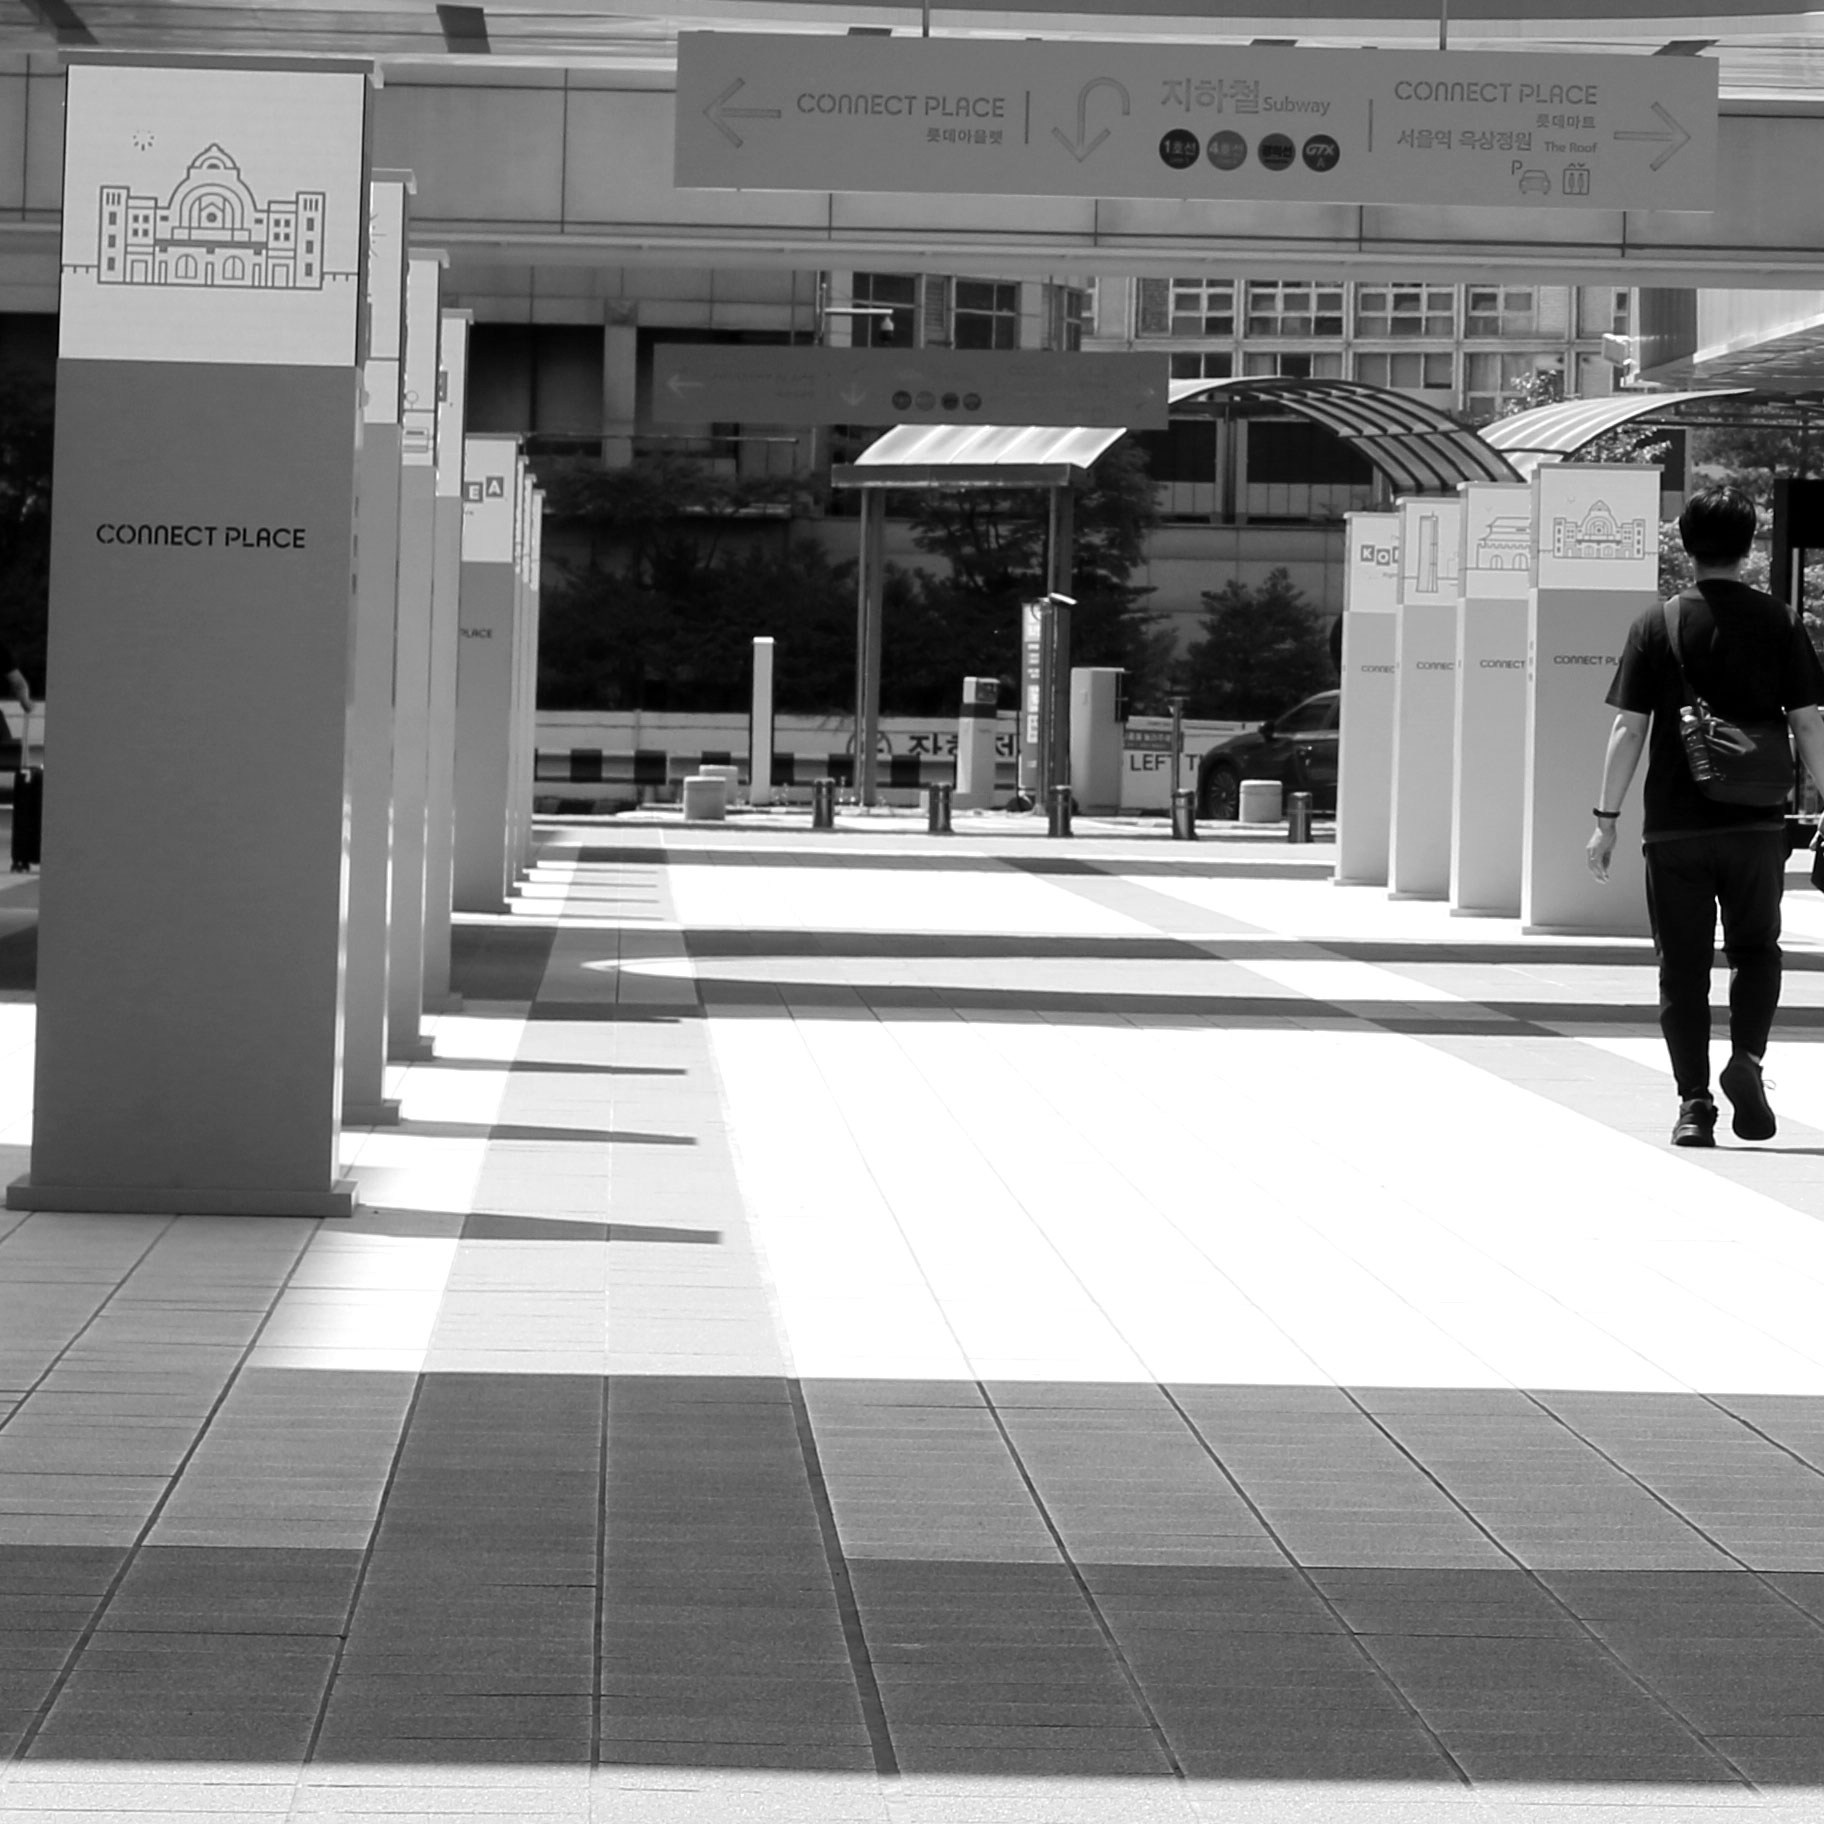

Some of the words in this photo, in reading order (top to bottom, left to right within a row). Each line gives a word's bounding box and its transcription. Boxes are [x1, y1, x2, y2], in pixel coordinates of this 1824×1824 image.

[1160, 78, 1260, 115] 지하철
[1263, 96, 1331, 117] Subway
[1394, 80, 1512, 103] CONNECT
[1519, 84, 1598, 105] PLACE
[797, 92, 917, 116] CONNECT
[925, 95, 1005, 118] PLACE
[1536, 113, 1596, 130] 롯데마트
[1397, 129, 1452, 150] 서울역
[1458, 130, 1532, 152] 옥상정원
[1544, 141, 1566, 153] The
[1569, 142, 1598, 153] Roof
[1305, 143, 1336, 156] GTX
[97, 523, 217, 547] CONNECT
[226, 526, 306, 550] PLACE
[1416, 661, 1454, 670] CONNEC
[1480, 659, 1525, 669] CONNECT
[1553, 655, 1602, 666] CONNECT
[1361, 664, 1395, 673] CONNEC
